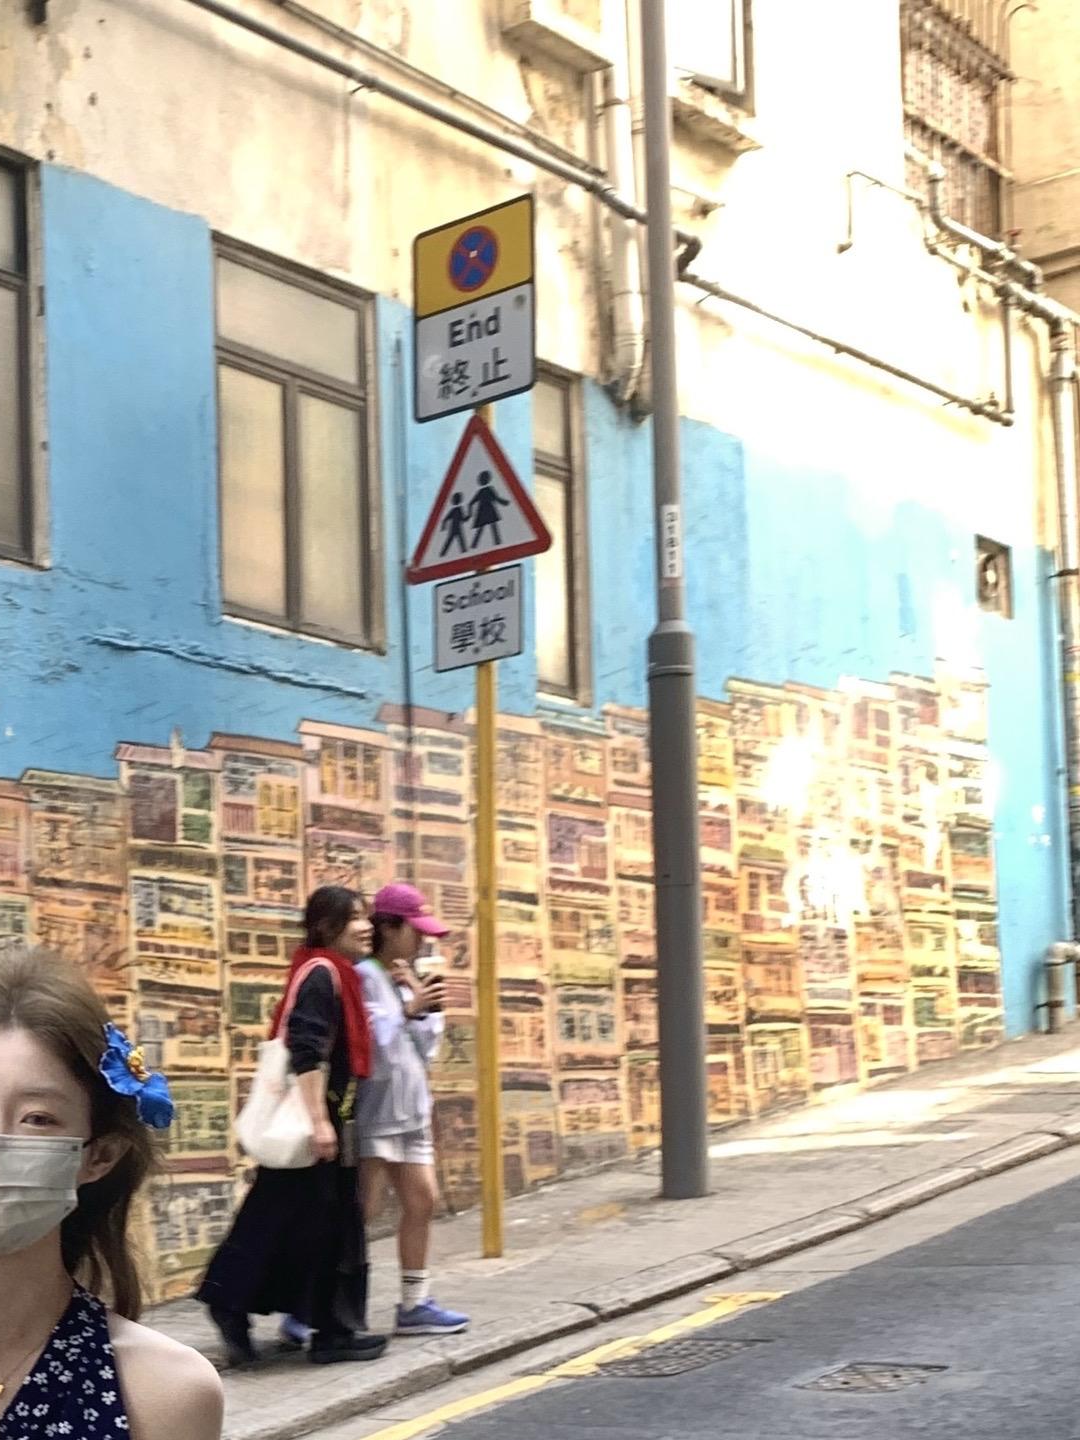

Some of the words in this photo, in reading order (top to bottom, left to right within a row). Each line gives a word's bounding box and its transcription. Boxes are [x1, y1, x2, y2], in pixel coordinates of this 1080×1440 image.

[448, 306, 501, 347] End
[438, 347, 512, 399] 終止
[442, 580, 515, 613] School
[451, 614, 507, 653] 學校
